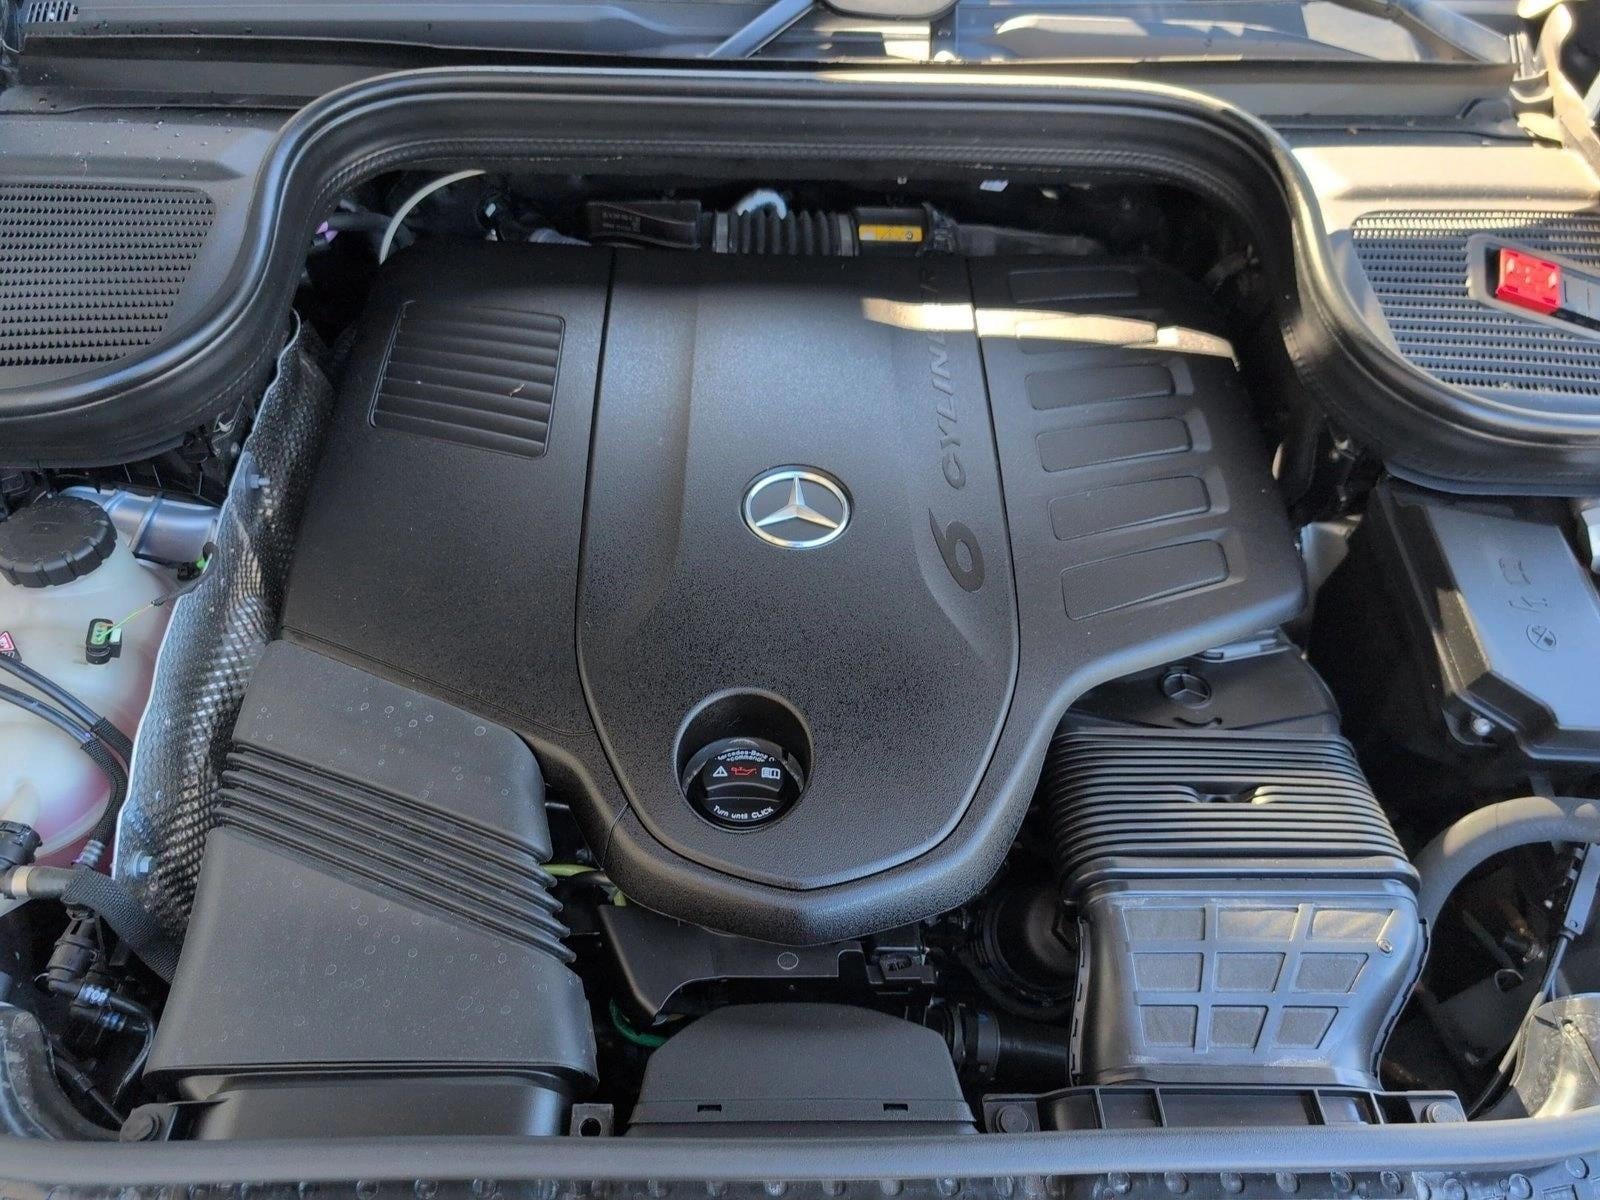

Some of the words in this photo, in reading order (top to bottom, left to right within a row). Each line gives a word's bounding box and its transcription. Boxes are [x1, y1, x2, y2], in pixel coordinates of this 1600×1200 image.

[928, 508, 985, 593] 6
[713, 805, 729, 816] Turn
[751, 806, 773, 818] CLICK
